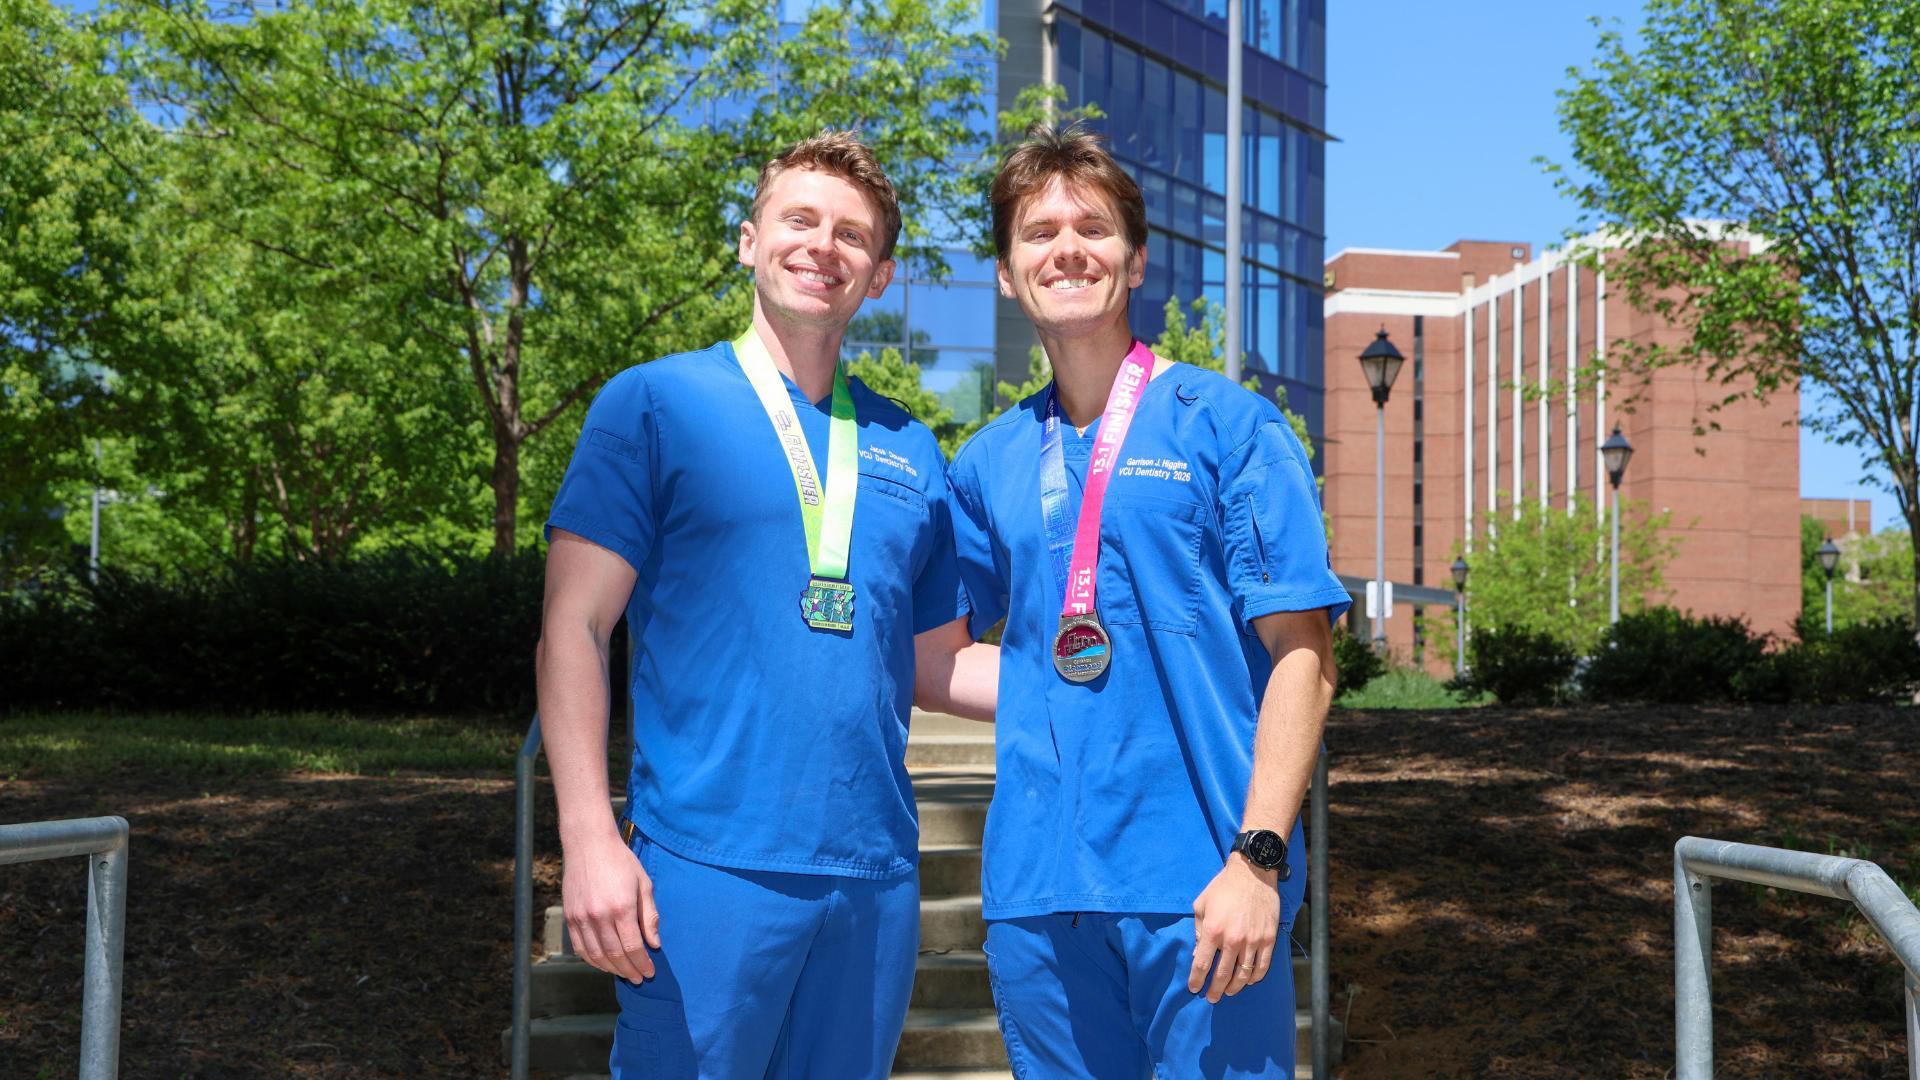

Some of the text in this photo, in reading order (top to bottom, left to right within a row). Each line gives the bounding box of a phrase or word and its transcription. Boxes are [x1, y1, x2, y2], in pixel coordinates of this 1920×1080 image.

[1093, 362, 1145, 475] 13.1 FINISHER
[858, 449, 873, 460] VCU
[1126, 457, 1153, 467] Garrison
[1161, 458, 1188, 471] Higgins
[783, 433, 820, 506] FINISHER
[1119, 466, 1191, 483] VCU Dentistry 2026
[1077, 567, 1091, 598] 13.1
